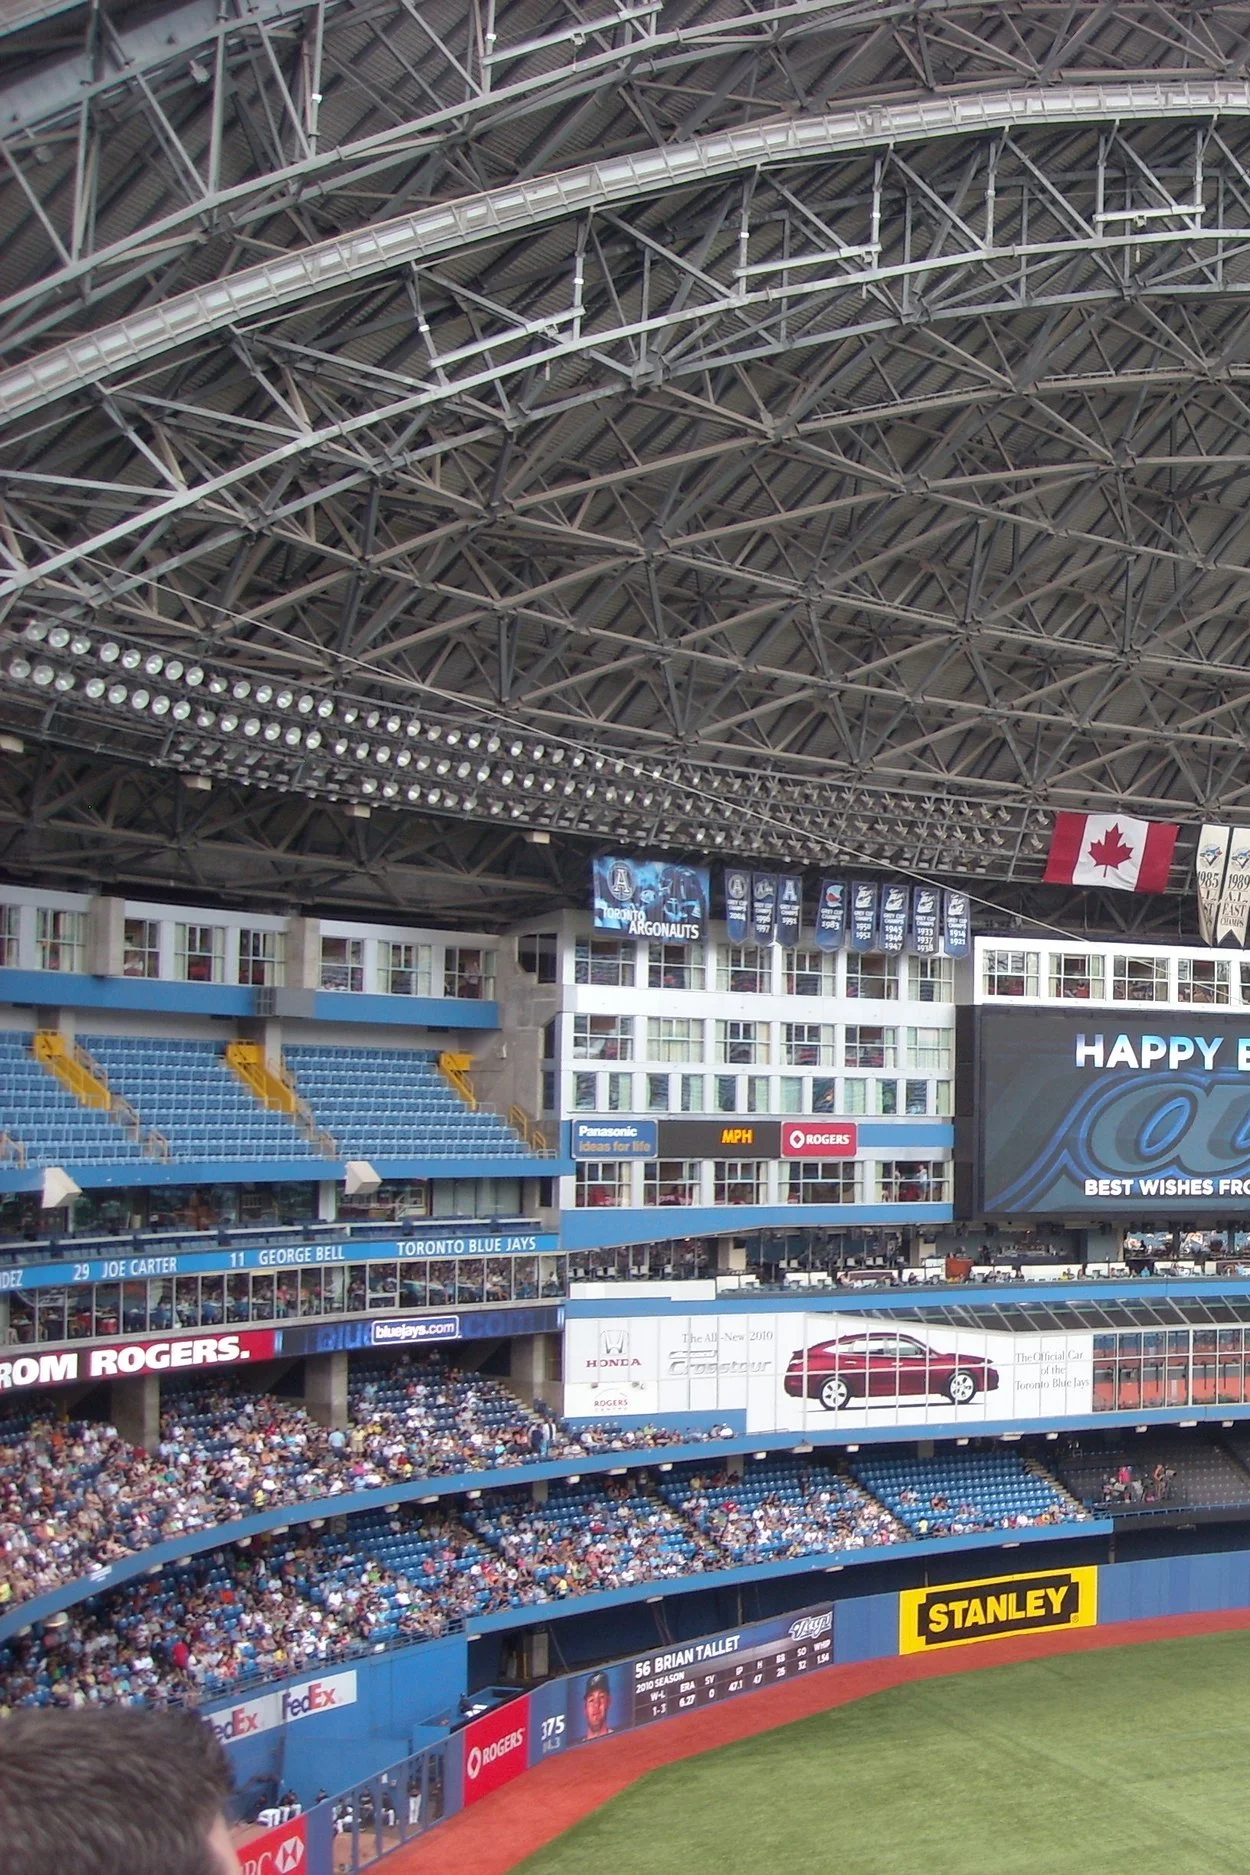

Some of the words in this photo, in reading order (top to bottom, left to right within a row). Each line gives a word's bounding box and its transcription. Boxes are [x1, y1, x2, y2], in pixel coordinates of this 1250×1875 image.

[1228, 873, 1250, 889] 1989
[602, 907, 647, 922] TORONTO
[1222, 903, 1246, 917] EAST
[628, 921, 699, 940] ARGONAUTS
[821, 920, 840, 931] 1983
[1075, 1033, 1224, 1070] HAPPY
[578, 1125, 638, 1138] Panasonic
[721, 1129, 753, 1144] MPH
[806, 1134, 850, 1145] ROGERS
[578, 1141, 611, 1153] ideas
[613, 1141, 629, 1152] for
[632, 1141, 651, 1153] life
[1084, 1178, 1134, 1196] BEST
[1138, 1179, 1214, 1196] WISHES
[73, 1263, 90, 1281] 29
[102, 1260, 126, 1278] JOE
[130, 1256, 177, 1276] CARTER
[229, 1252, 245, 1268] 11
[258, 1247, 313, 1266] GEORGE
[315, 1246, 345, 1262] BELL
[396, 1239, 465, 1257] TORONTO
[468, 1238, 502, 1254] BLUE
[506, 1236, 537, 1251] JAYS
[375, 1321, 455, 1340] bluejays.com
[682, 1333, 702, 1344] The
[749, 1330, 774, 1342] 2010
[90, 1336, 250, 1377] ROGERS.
[585, 1358, 643, 1368] HONDA
[1015, 1353, 1033, 1363] The
[1033, 1350, 1065, 1362] Official
[1067, 1350, 1084, 1360] Car
[668, 1360, 773, 1376] Crosstour
[1040, 1366, 1049, 1376] of
[1052, 1364, 1066, 1375] the
[1016, 1380, 1050, 1391] Toronto
[1052, 1378, 1072, 1388] Blue
[1073, 1377, 1090, 1390] Jays
[594, 1399, 628, 1407] ROGERS
[928, 1585, 1069, 1633] STANLEY
[635, 1662, 651, 1679] 56
[654, 1647, 694, 1674] BRIAN
[695, 1635, 741, 1659] TALLET
[650, 1690, 667, 1701] W-L
[680, 1681, 696, 1693] ERA
[797, 1647, 807, 1657] SO
[635, 1682, 654, 1694] 2010
[654, 1671, 685, 1688] SEASON
[281, 1682, 336, 1720] FedEx
[541, 1714, 566, 1741] 375
[482, 1728, 525, 1767] ROGERS
